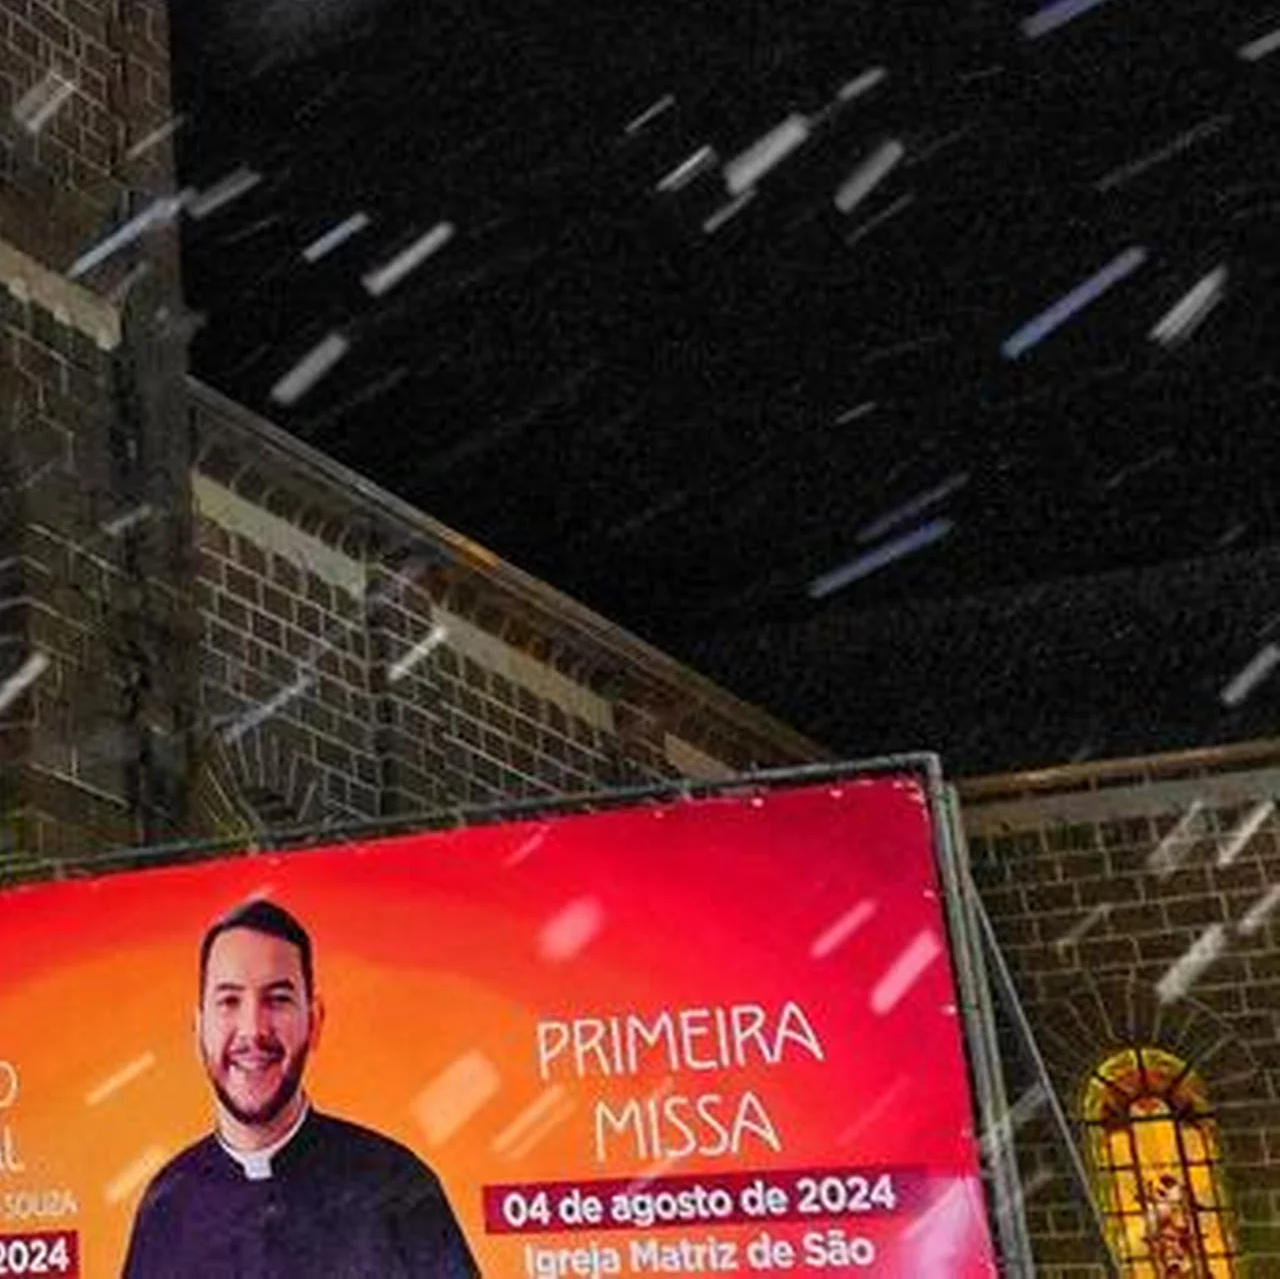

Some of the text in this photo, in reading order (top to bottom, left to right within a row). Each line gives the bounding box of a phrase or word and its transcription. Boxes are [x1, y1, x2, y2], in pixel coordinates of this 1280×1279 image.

[539, 1000, 826, 1080] PRIMEIRA
[594, 1090, 782, 1164] MISSA
[503, 1173, 897, 1228] 04 de agosto de 2024
[525, 1228, 876, 1279] Igreja Matriz de São
